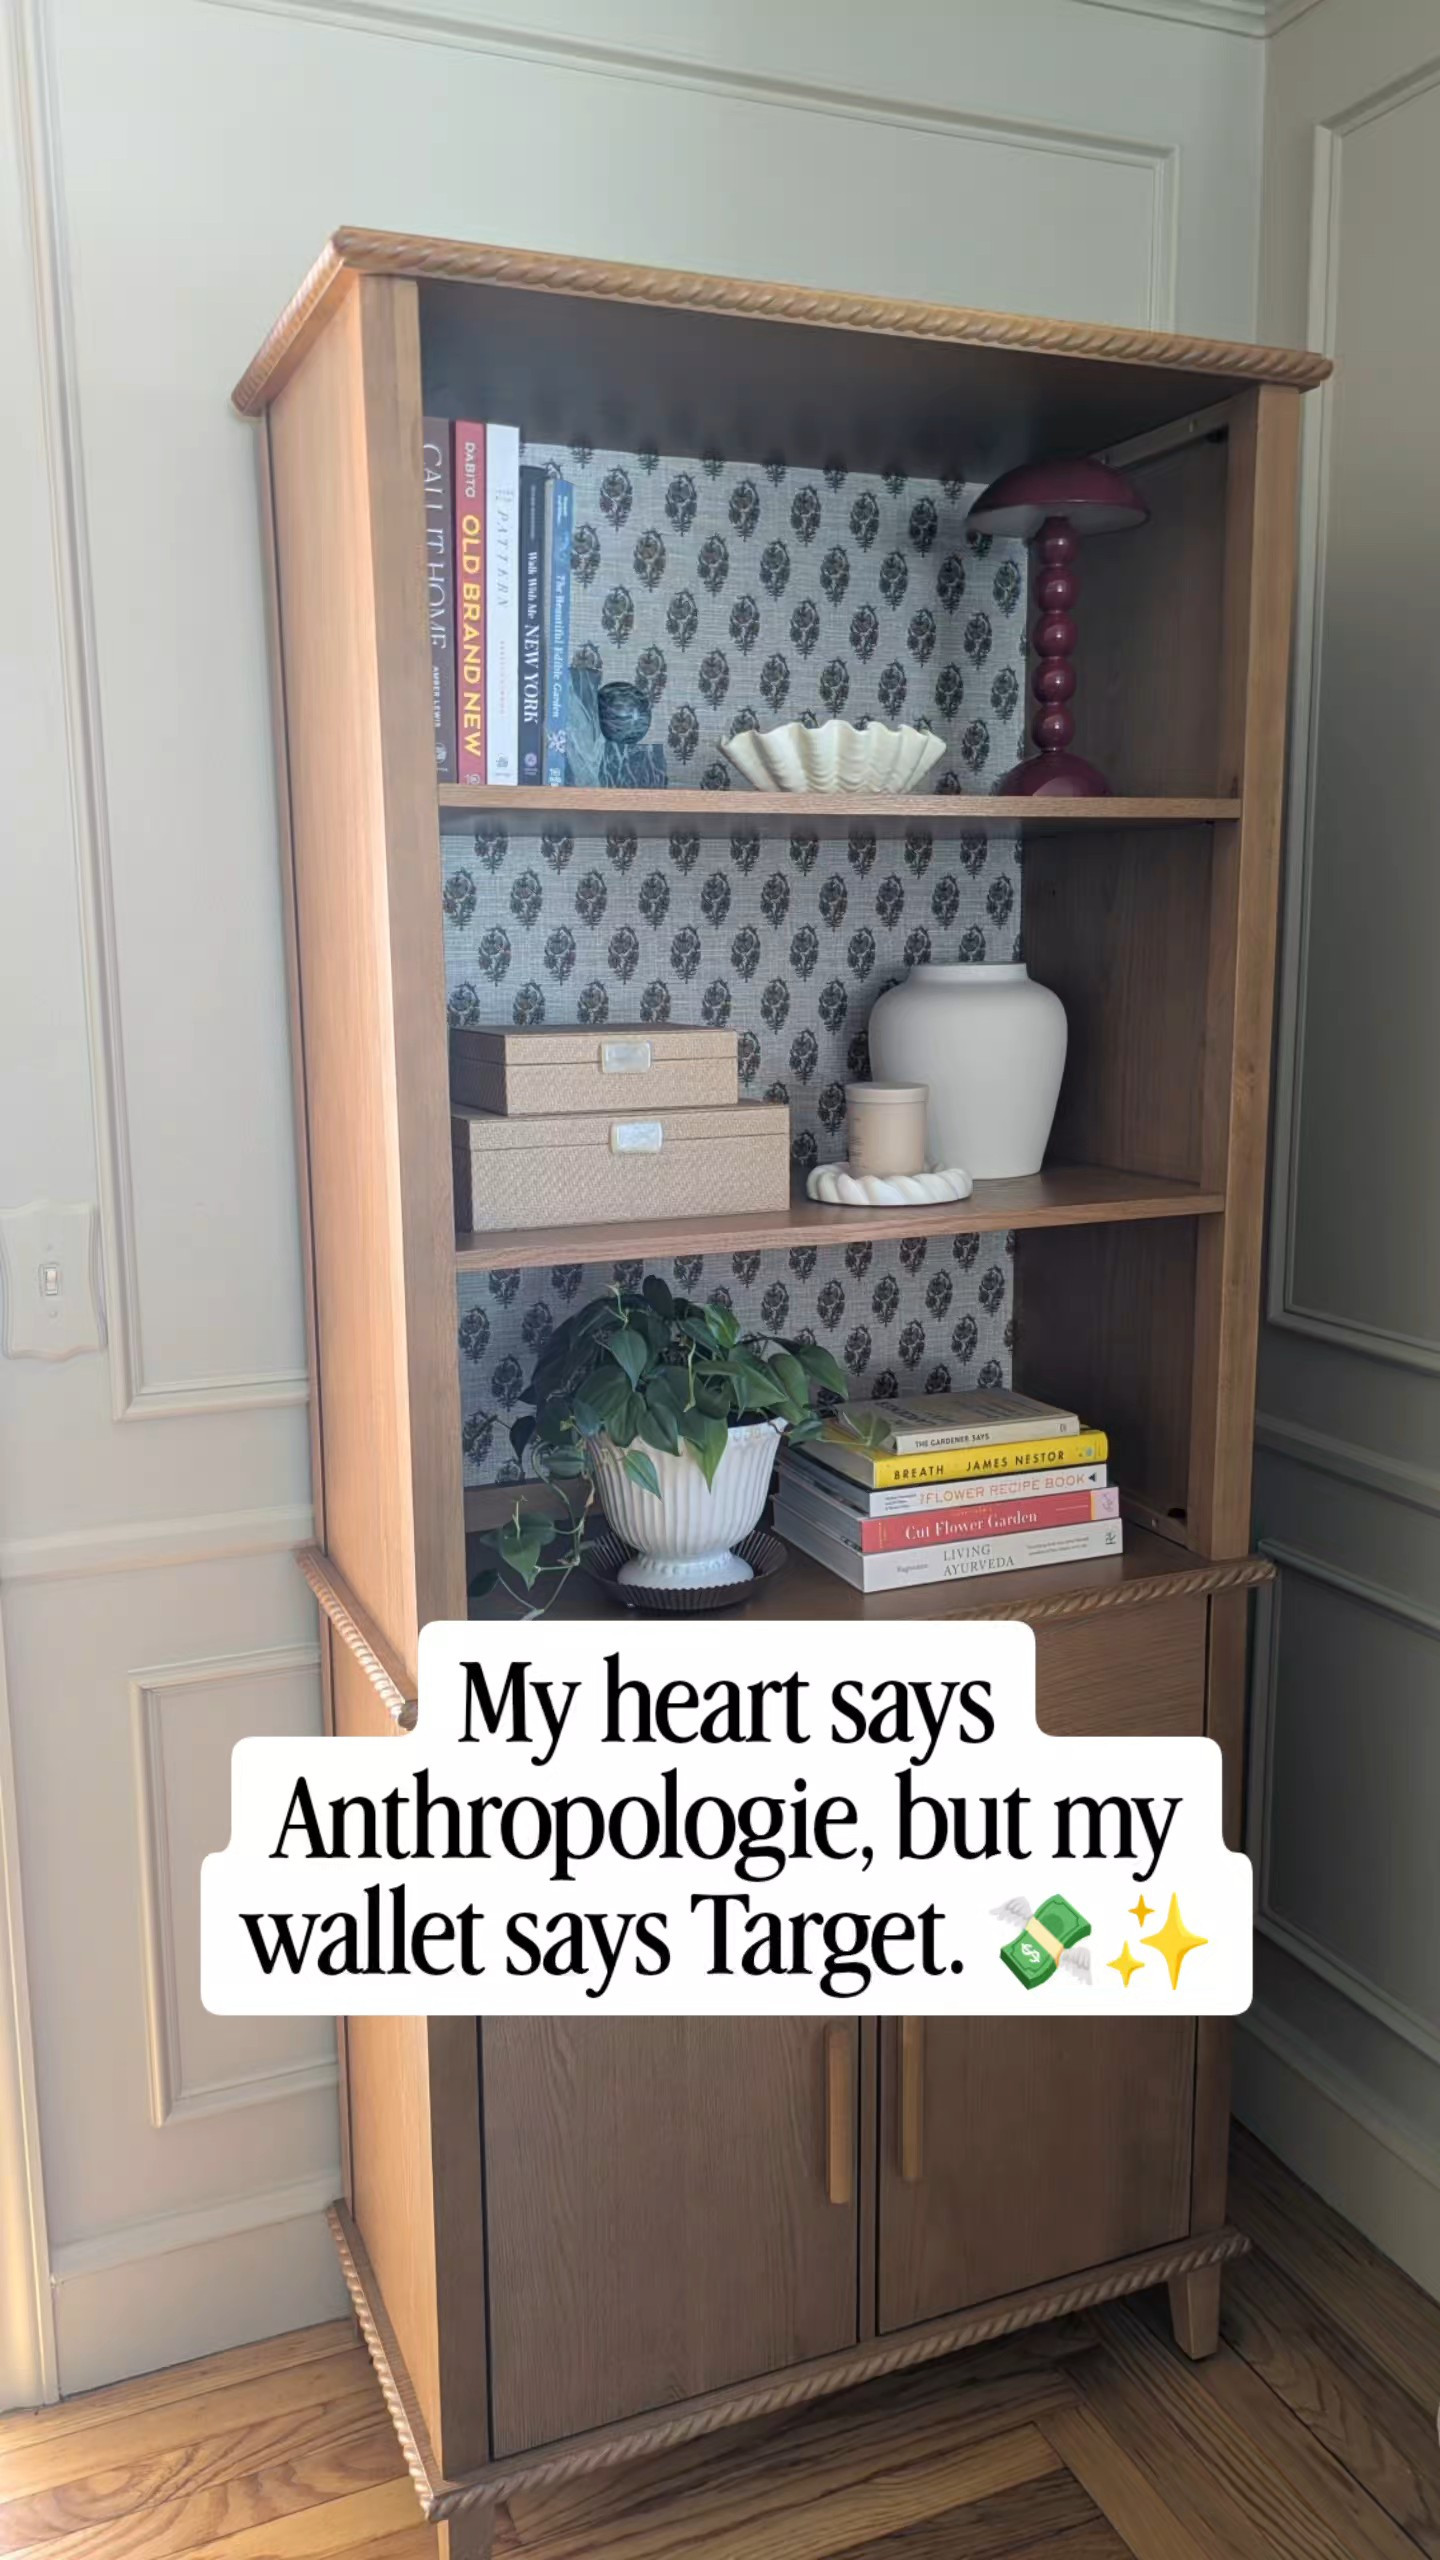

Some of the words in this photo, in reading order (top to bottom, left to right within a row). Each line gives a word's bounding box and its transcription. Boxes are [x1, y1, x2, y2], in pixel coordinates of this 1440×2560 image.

[464, 442, 476, 498] DABITO
[462, 514, 481, 575] OLD
[527, 551, 538, 575] Walk
[527, 578, 538, 601] With
[527, 603, 538, 620] Me
[463, 583, 481, 684] BRAND
[524, 624, 540, 669] NEW
[553, 645, 564, 679] Edible
[523, 673, 540, 724] YORK
[551, 683, 562, 718] Garden
[463, 691, 482, 757] NEW
[915, 1440, 928, 1448] THE
[930, 1435, 969, 1447] GARDENER
[972, 1433, 990, 1441] SAYS
[894, 1465, 944, 1480] BREATH
[966, 1456, 1008, 1472] JAMES
[1015, 1450, 1065, 1466] NESTOR
[926, 1486, 985, 1505] FLOWER
[990, 1479, 1040, 1496] RECIPE
[1045, 1473, 1085, 1489] BOOK
[905, 1525, 930, 1540] Cut
[935, 1519, 985, 1536] Flower
[987, 1510, 1037, 1528] Garden
[943, 1543, 991, 1561] LIVING
[943, 1556, 1015, 1577] AYURVEDA
